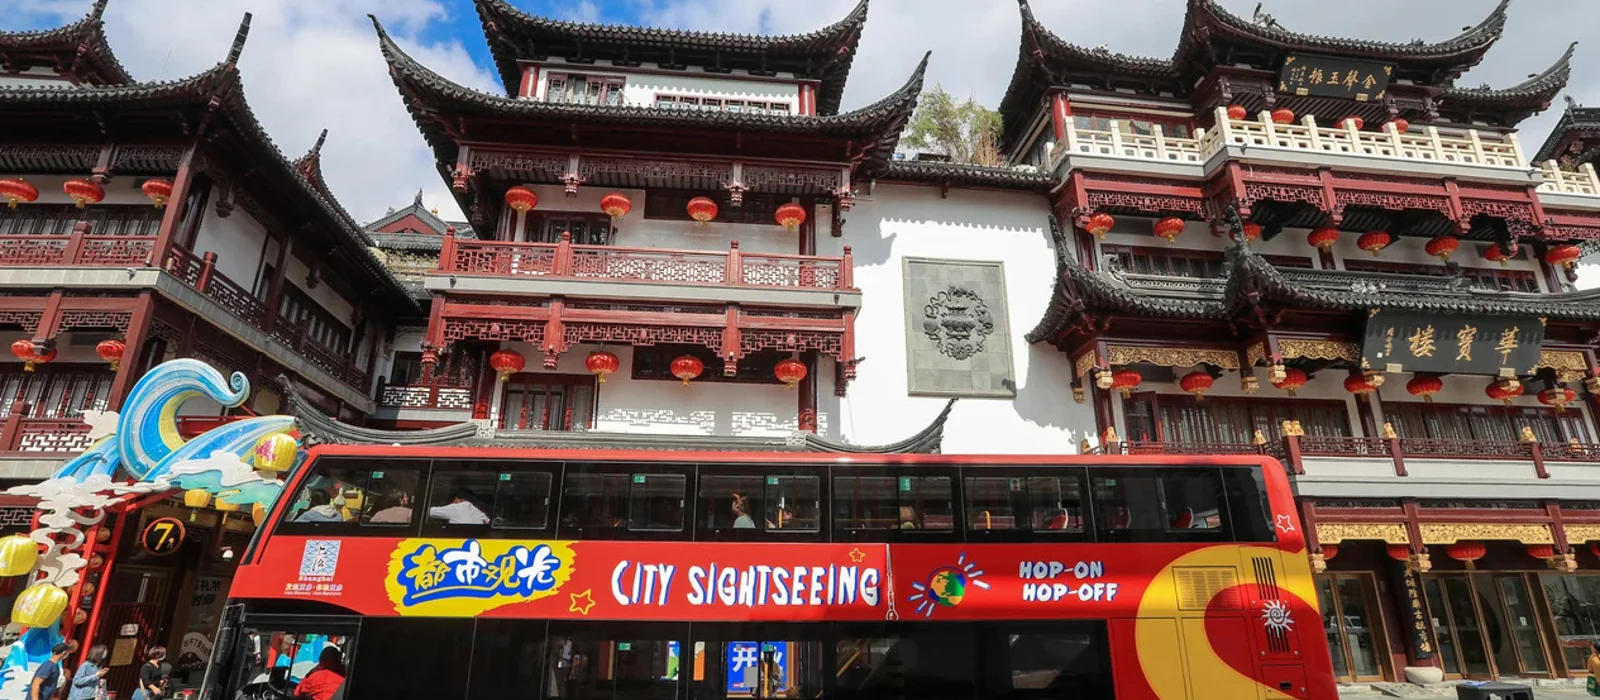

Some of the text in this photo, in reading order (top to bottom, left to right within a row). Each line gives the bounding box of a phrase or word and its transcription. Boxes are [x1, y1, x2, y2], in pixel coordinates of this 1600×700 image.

[154, 523, 175, 551] 7
[406, 541, 559, 592] 都市观光
[1019, 561, 1104, 580] HOP-ON
[611, 560, 881, 607] CITY SIGHTSEEING
[1023, 582, 1118, 602] HOP-OFF
